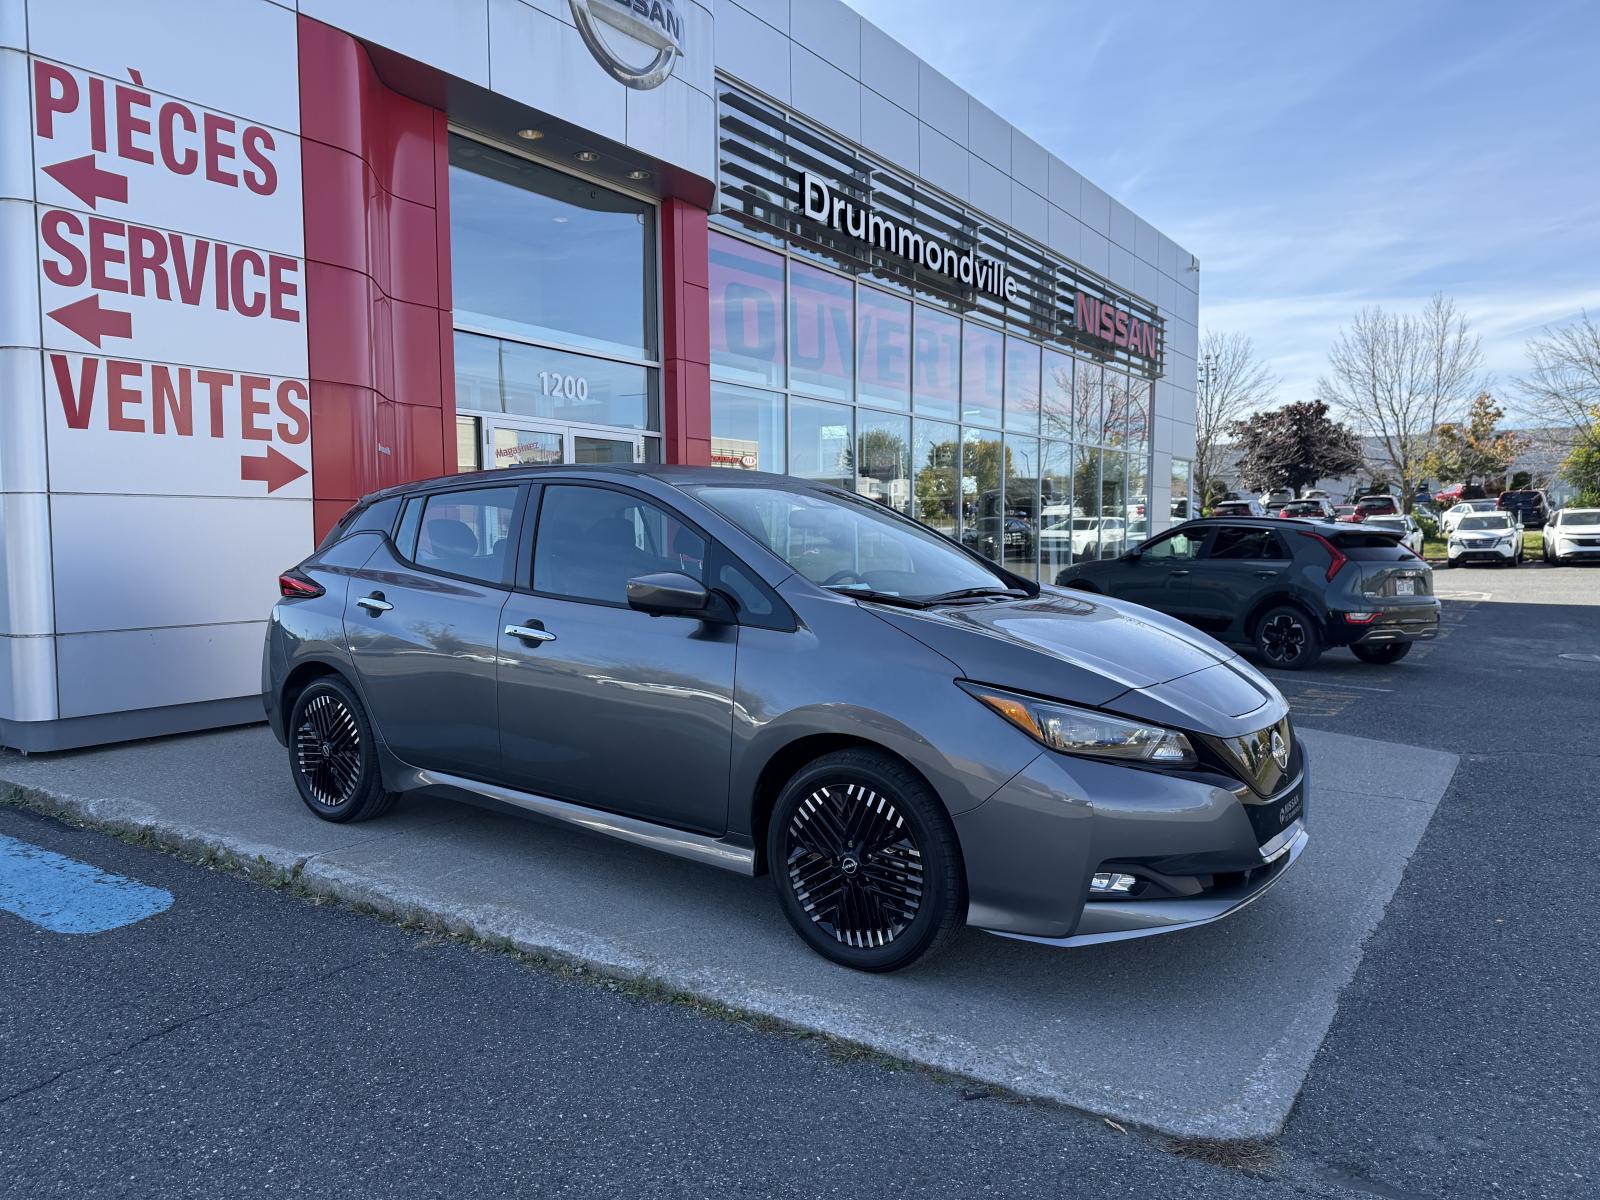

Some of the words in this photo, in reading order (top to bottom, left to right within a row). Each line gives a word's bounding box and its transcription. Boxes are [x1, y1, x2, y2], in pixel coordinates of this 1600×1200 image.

[614, 0, 680, 39] SAN
[34, 60, 278, 195] PIÈCES
[41, 209, 300, 322] SERVICE
[801, 171, 1018, 301] Drummondville
[1076, 291, 1156, 359] NISSAN
[50, 354, 310, 445] VENTES
[538, 371, 588, 401] 1200
